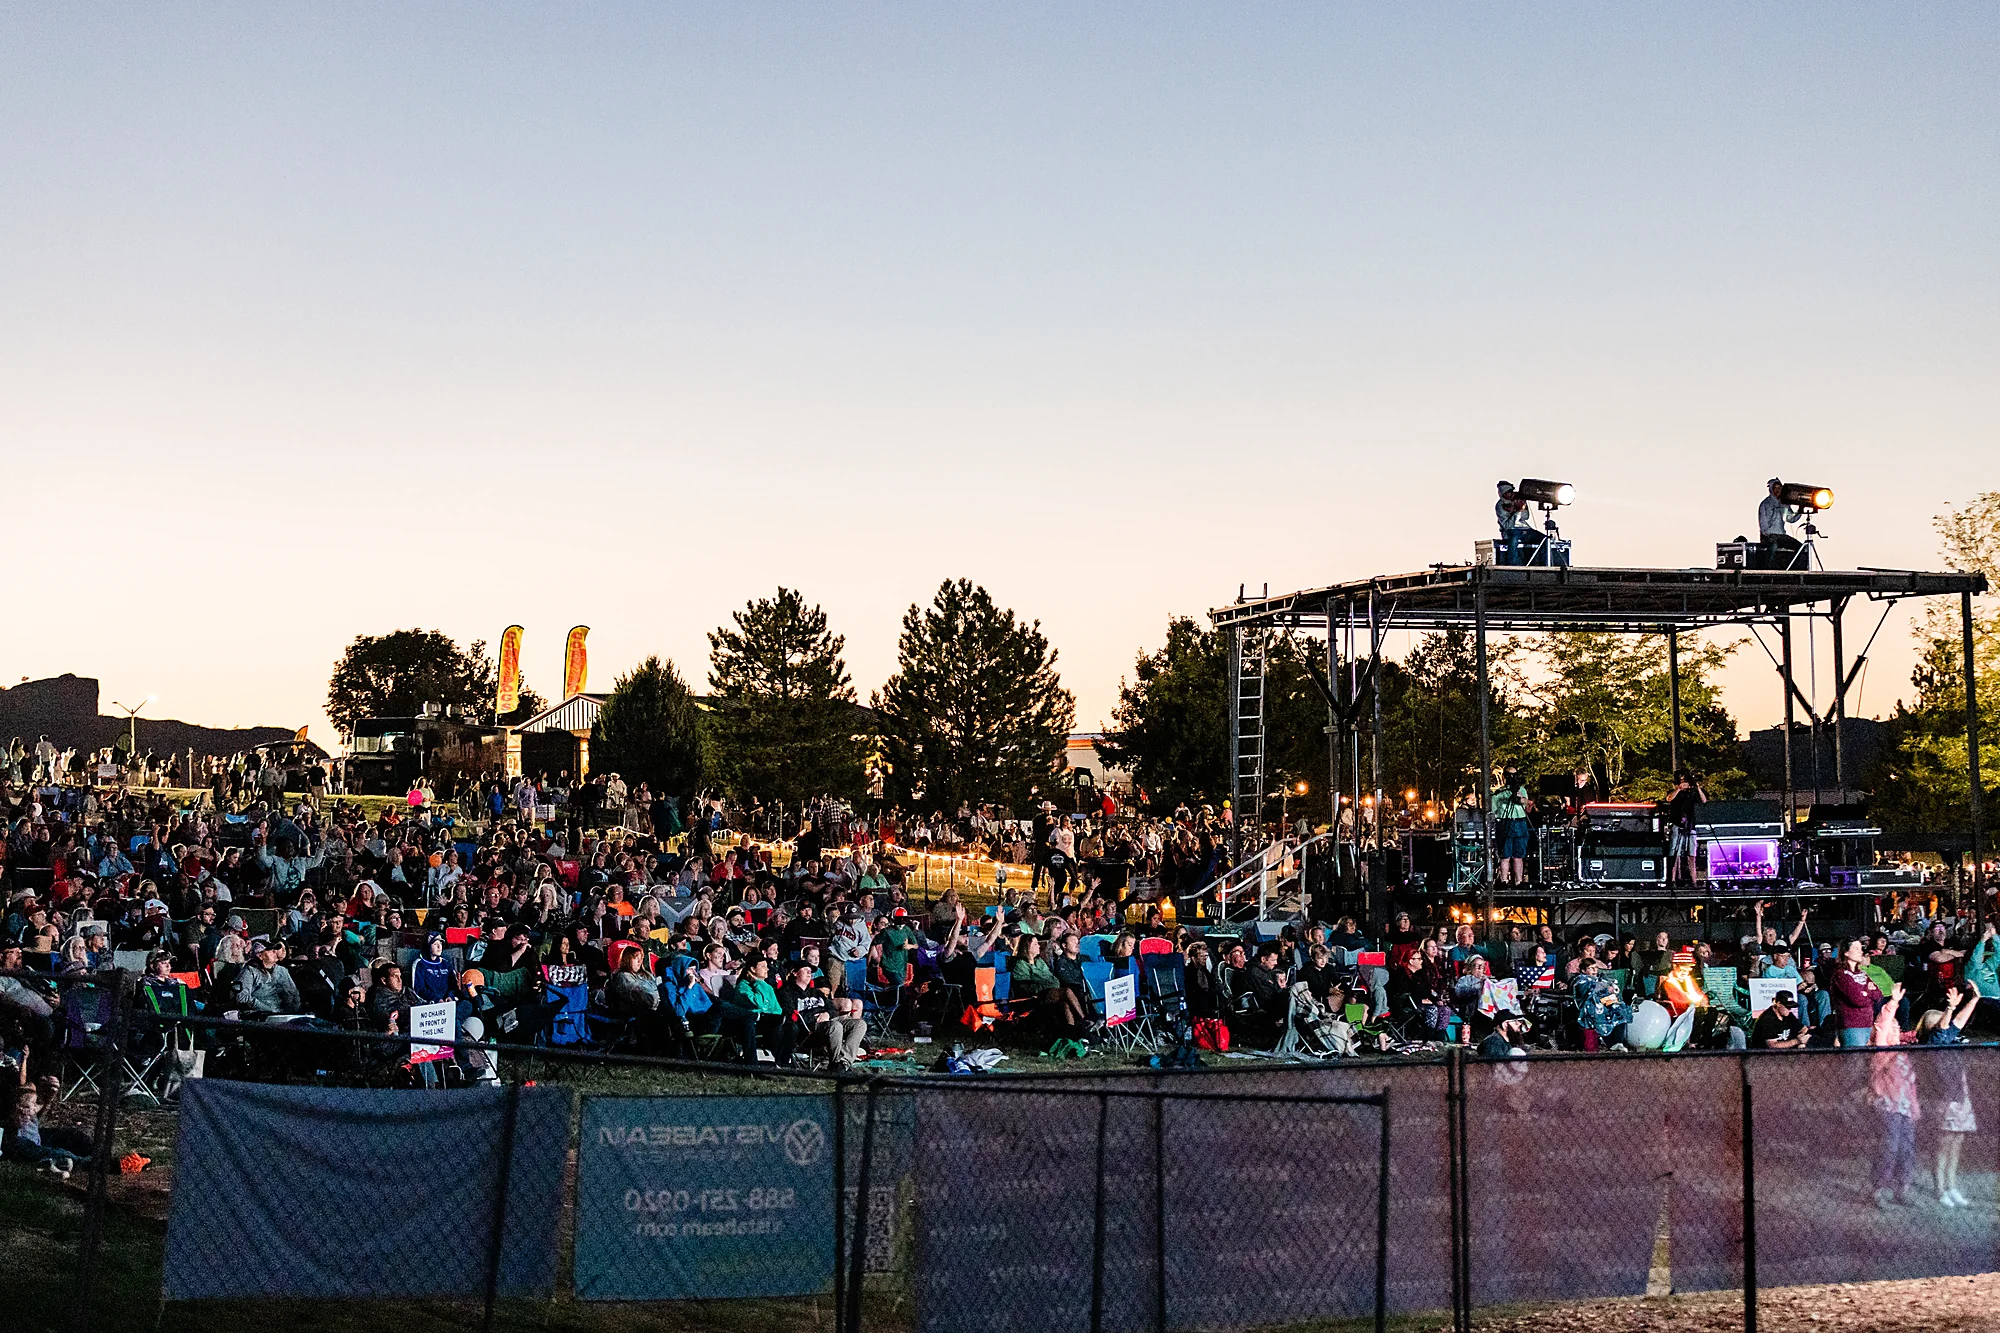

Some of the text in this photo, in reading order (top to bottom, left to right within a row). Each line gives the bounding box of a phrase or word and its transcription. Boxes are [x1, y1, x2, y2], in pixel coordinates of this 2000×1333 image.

[428, 1009, 446, 1018] CHAIRS
[425, 1019, 440, 1027] FRONT
[434, 1027, 444, 1035] LINE
